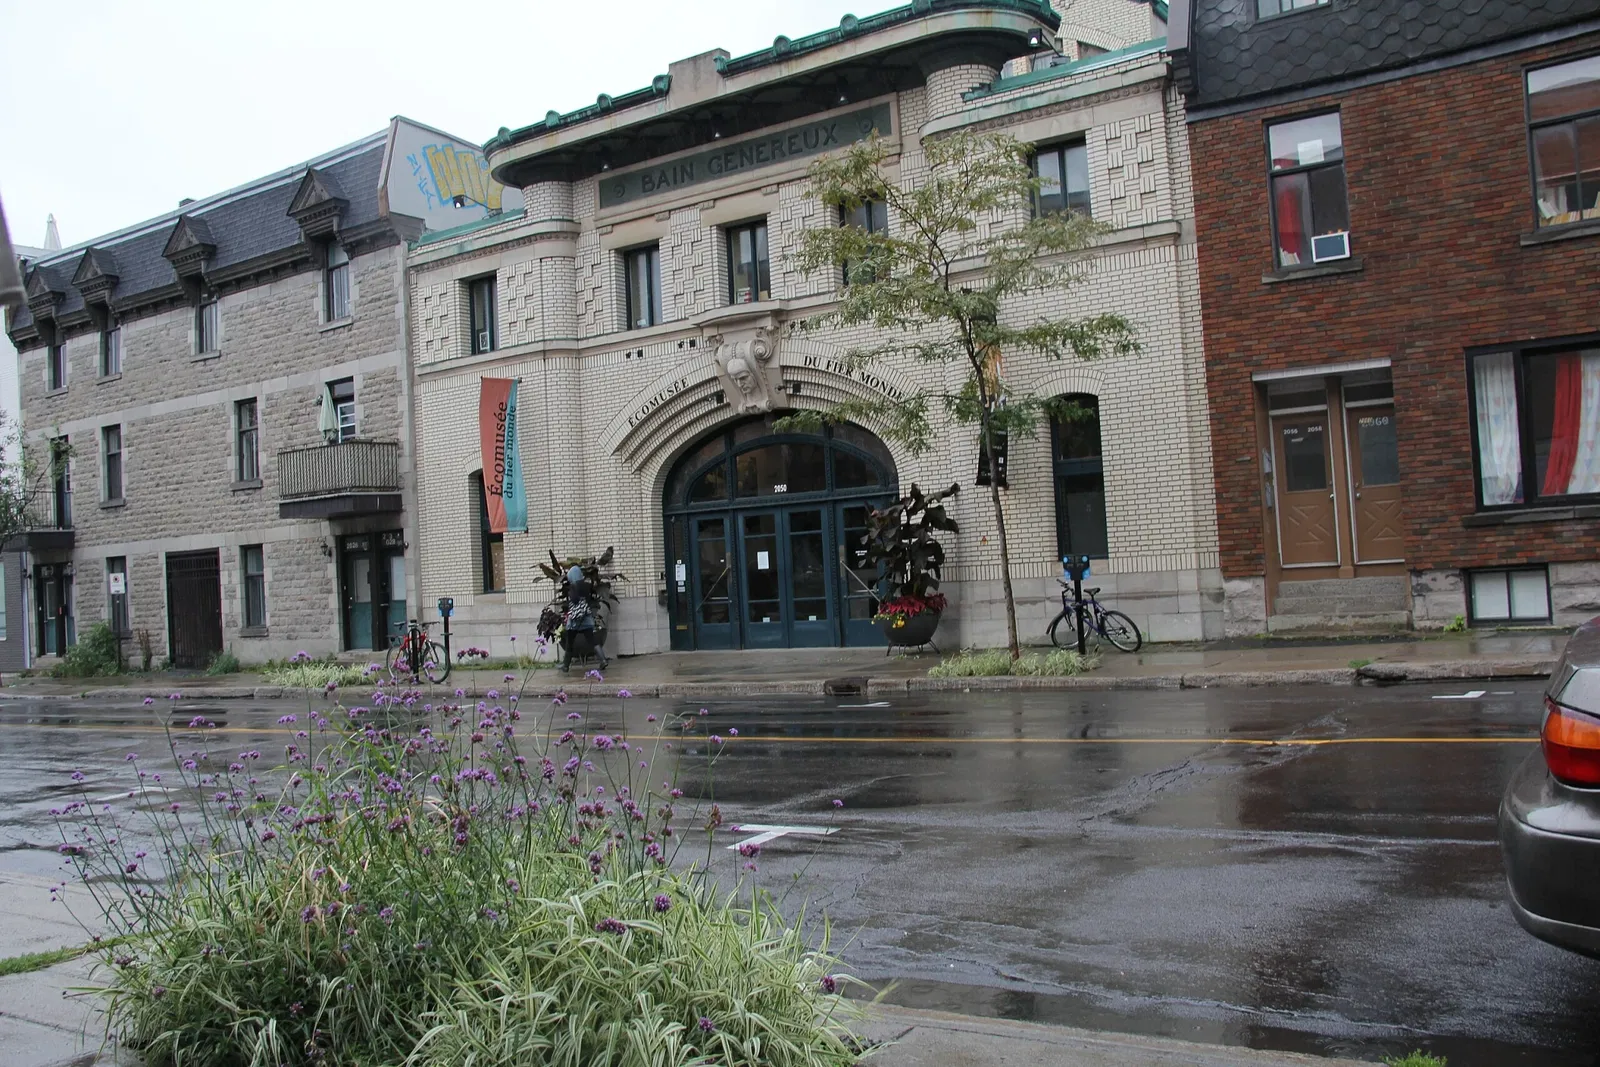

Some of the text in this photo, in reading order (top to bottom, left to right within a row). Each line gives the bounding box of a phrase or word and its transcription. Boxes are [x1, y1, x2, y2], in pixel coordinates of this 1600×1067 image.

[641, 123, 838, 193] BAIN GENEREUX
[628, 376, 690, 428] ÉCOMUSÉE
[804, 355, 821, 368] DU
[826, 360, 853, 378] FIER
[487, 401, 508, 498] Écomusée
[506, 405, 517, 451] monde
[504, 482, 514, 499] du
